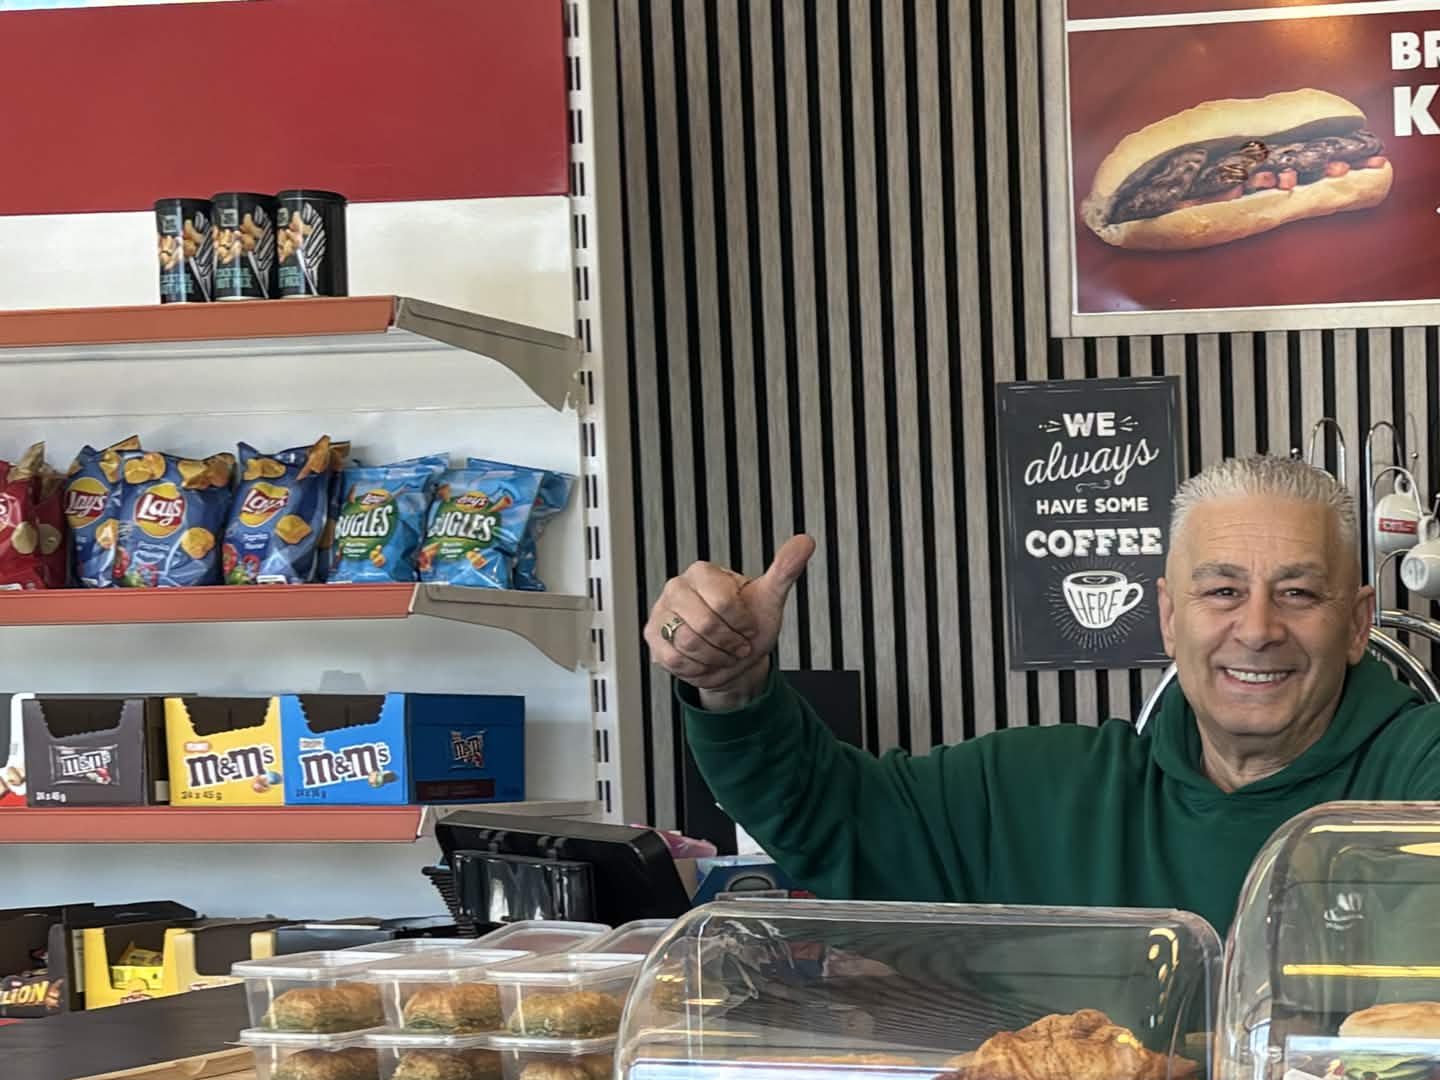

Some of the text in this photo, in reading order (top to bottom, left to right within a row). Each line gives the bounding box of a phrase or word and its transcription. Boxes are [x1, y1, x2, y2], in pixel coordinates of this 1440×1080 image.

[1062, 412, 1116, 437] WE
[1024, 438, 1160, 486] always
[1036, 496, 1149, 515] HAVE SOME
[1025, 527, 1163, 558] COFFEE
[1067, 588, 1122, 625] HERE
